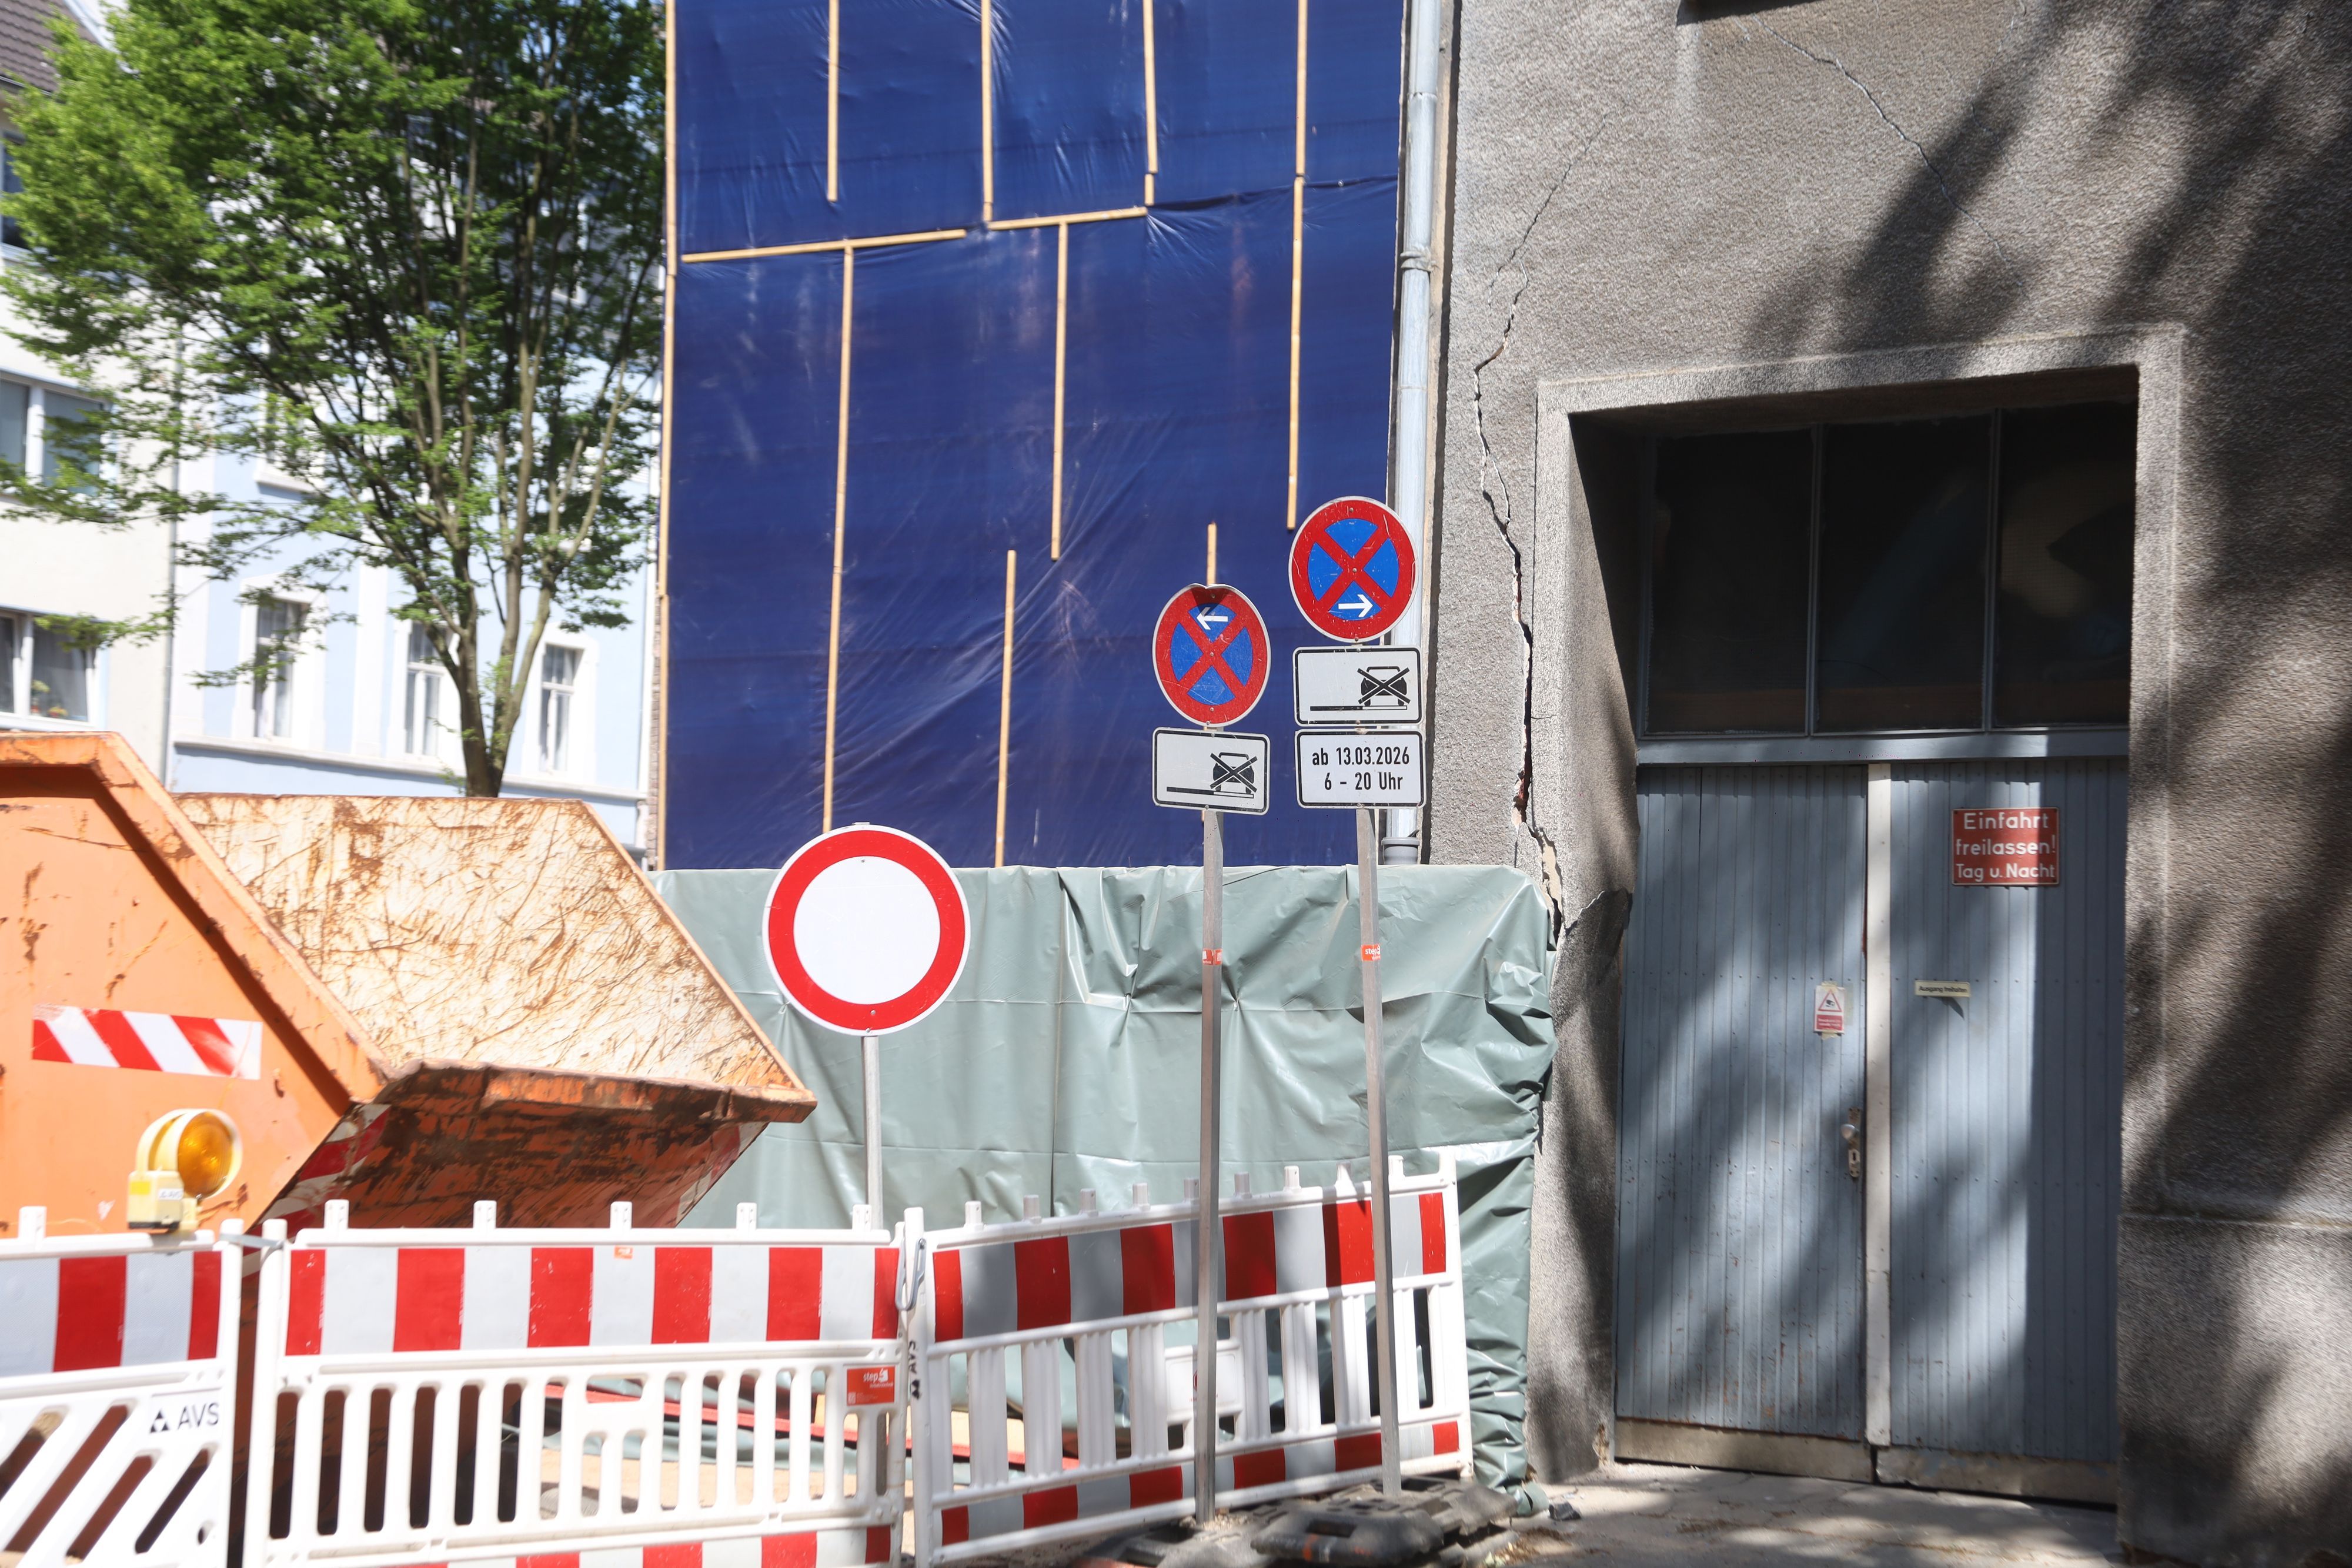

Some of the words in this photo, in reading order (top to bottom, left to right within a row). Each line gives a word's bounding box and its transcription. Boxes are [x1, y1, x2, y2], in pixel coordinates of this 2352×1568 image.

[1312, 747, 1329, 765] ab
[1336, 746, 1410, 765] 13.03.2026
[1324, 772, 1332, 791] 6
[1355, 772, 1371, 790] 20
[1379, 771, 1403, 790] Uhr
[1963, 811, 2049, 830] Einfahrt
[1956, 834, 2056, 855] freilassen!
[1956, 863, 1984, 882] Tag
[1989, 867, 2003, 878] u.
[2006, 862, 2056, 878] Nacht
[1365, 947, 1378, 956] step
[1919, 985, 1943, 994] Ausgang
[863, 1371, 879, 1383] step
[177, 1402, 220, 1430] AVS
